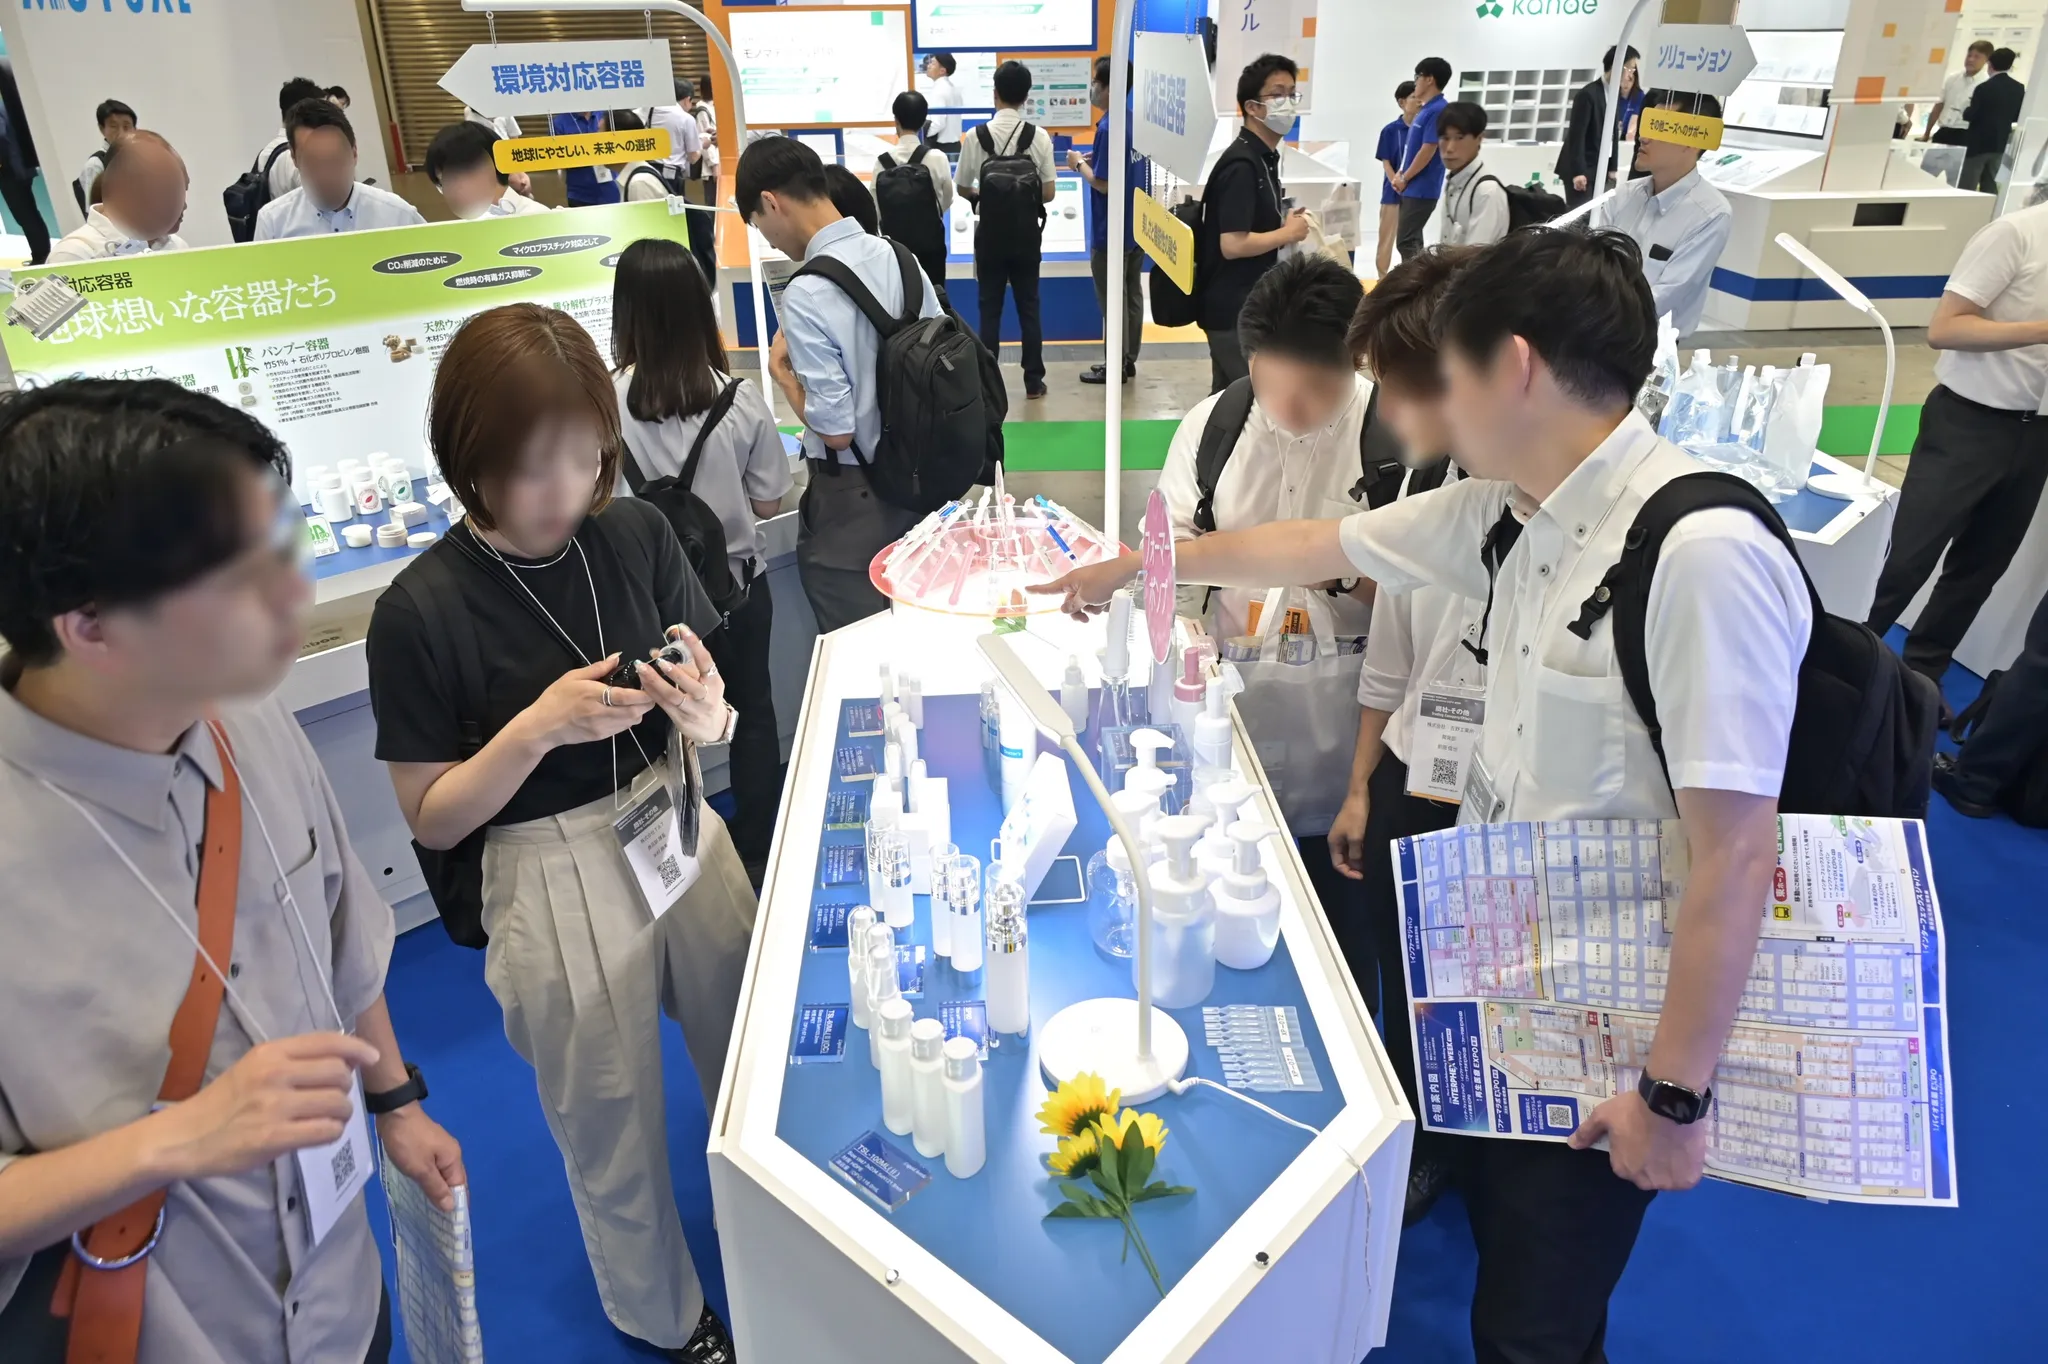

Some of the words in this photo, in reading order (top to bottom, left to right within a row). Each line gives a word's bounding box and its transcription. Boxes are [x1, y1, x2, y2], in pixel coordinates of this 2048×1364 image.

[1658, 45, 1732, 72] ソリューション
[492, 60, 645, 95] 環境対応容器
[1144, 69, 1186, 136] 化粧品容器
[1650, 118, 1709, 140] その他ニーズへのサポート
[511, 138, 656, 162] 地球にやさしい、未来への選択
[512, 236, 600, 254] マイクロプラスチック対応として
[455, 270, 532, 287] 燃焼時の有毒ガス抑制に
[262, 338, 330, 358] バンブー容器
[264, 359, 288, 370] 竹51%
[299, 345, 370, 364] 石化ポリプロピレン樹脂
[1776, 871, 1785, 897] 東ホール
[1912, 868, 1929, 949] インターフェックスジャパン
[1407, 916, 1415, 960] インファーマジャパン
[1447, 1041, 1455, 1060] WEEK
[1448, 1062, 1459, 1104] INTERPHEX
[1428, 1073, 1443, 1122] 会場案内図
[1495, 1098, 1504, 1128] ファーマラボ
